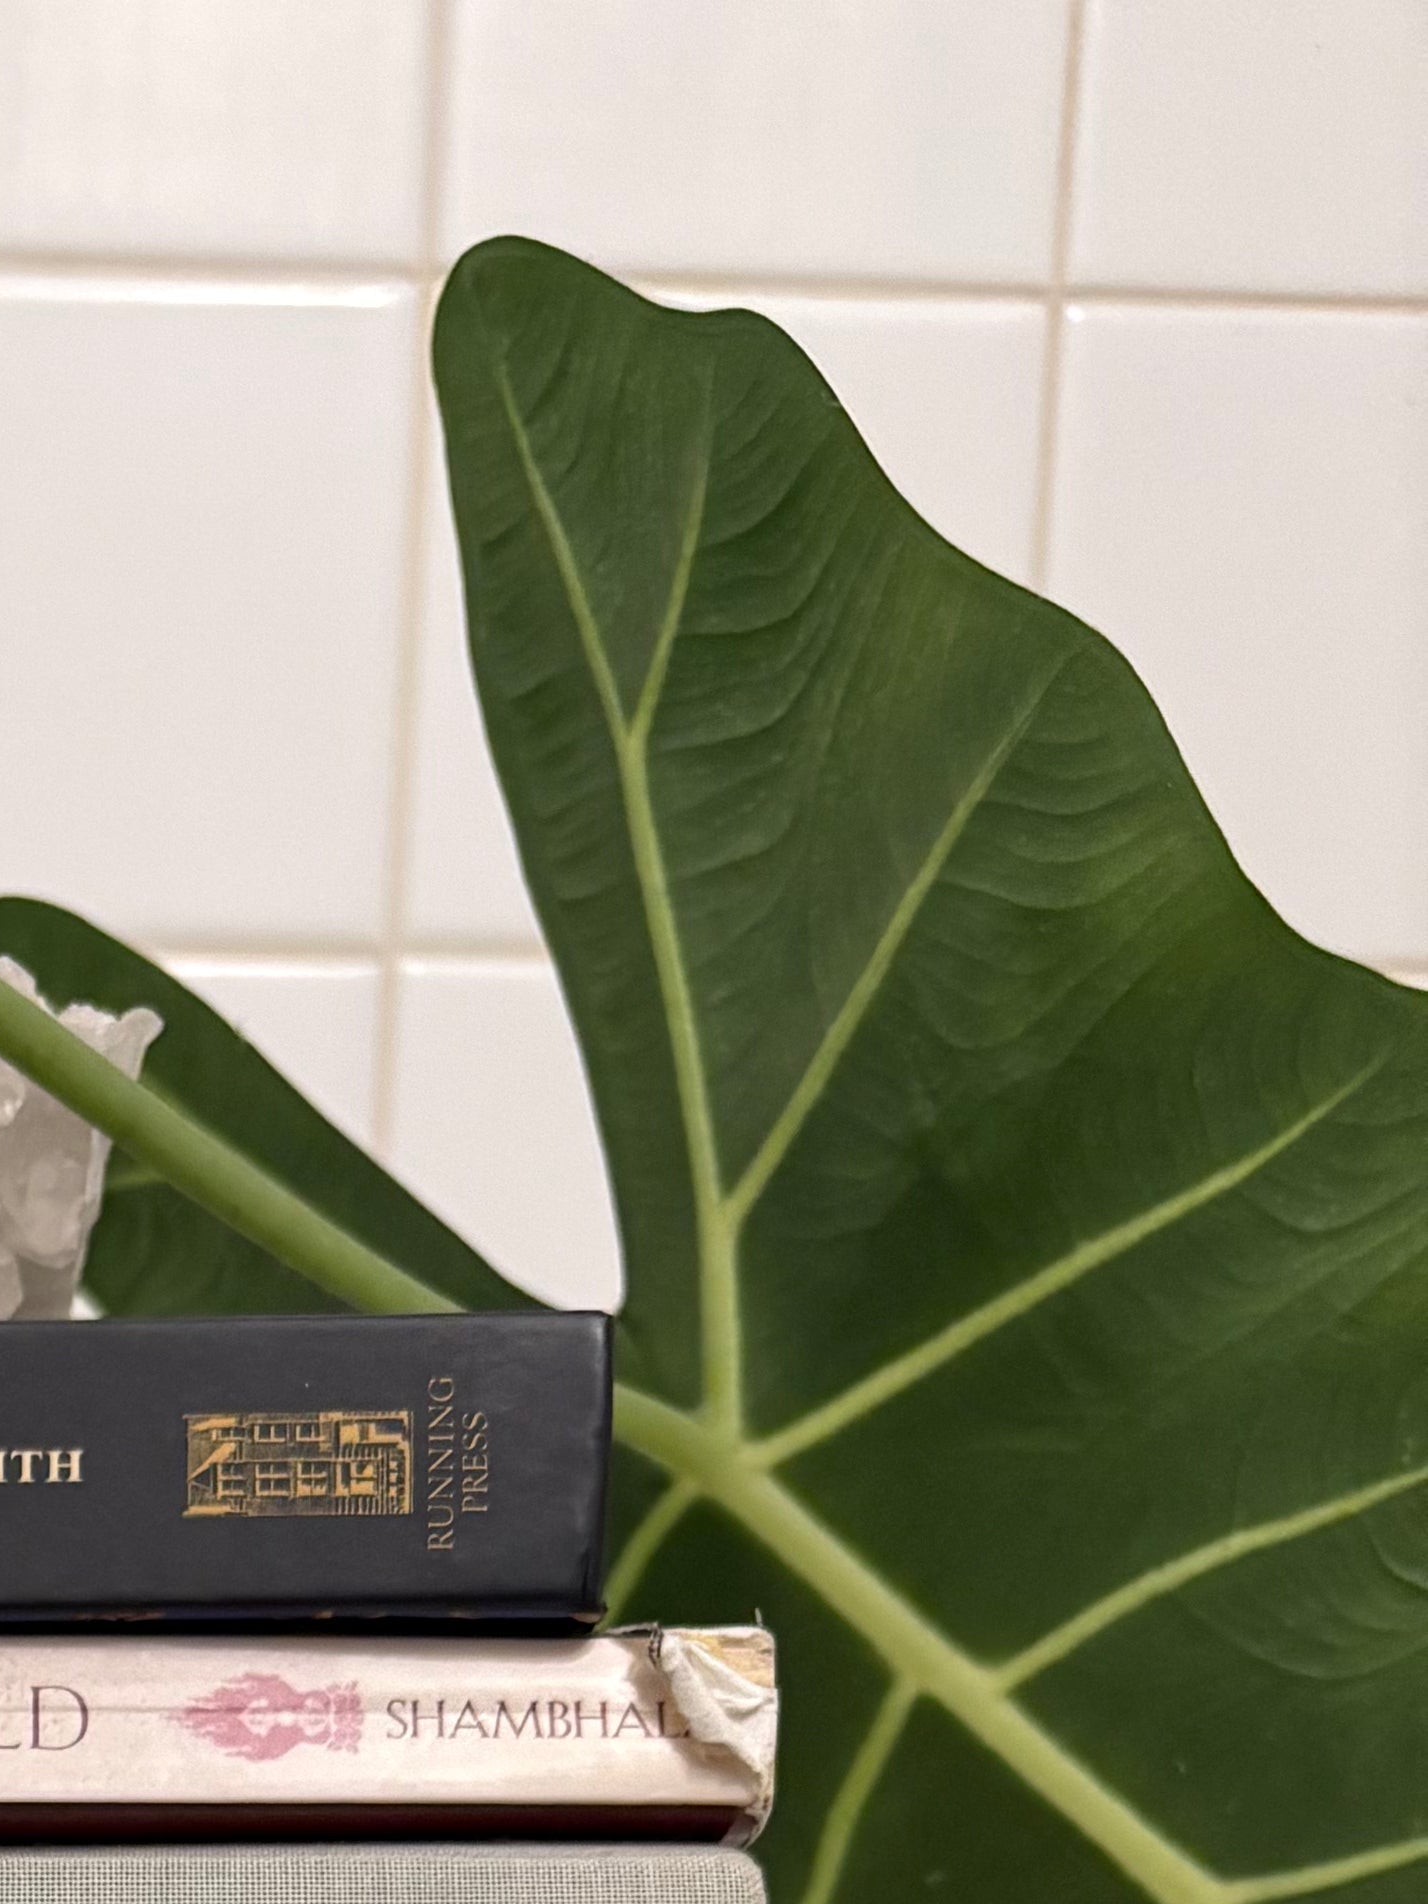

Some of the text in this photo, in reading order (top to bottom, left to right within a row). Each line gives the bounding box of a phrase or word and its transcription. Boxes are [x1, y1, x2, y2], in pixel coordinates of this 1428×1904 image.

[427, 1376, 455, 1549] RUNNING
[462, 1411, 489, 1512] PRESS
[386, 1700, 690, 1739] SHAMBHAL
